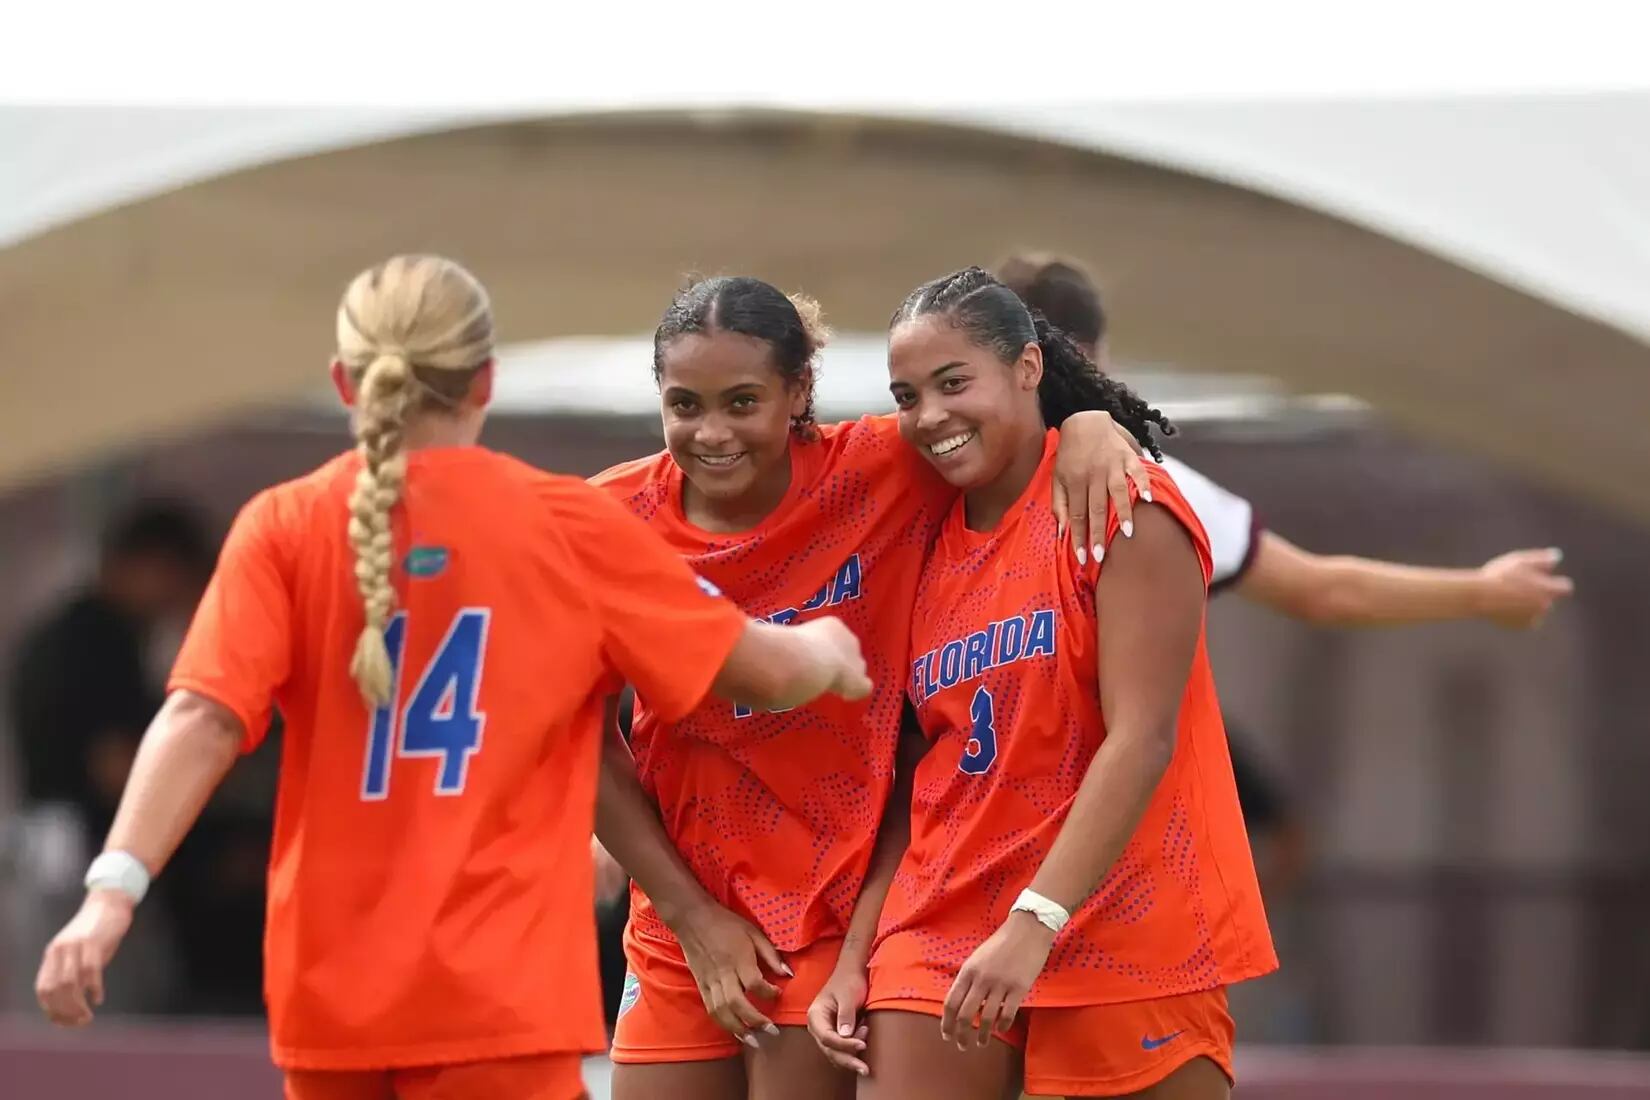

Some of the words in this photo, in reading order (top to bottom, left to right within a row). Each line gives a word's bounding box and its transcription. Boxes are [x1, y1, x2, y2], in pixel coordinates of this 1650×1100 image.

[360, 606, 491, 801] 14
[912, 609, 1056, 708] FLORIDA
[957, 685, 998, 775] 3
